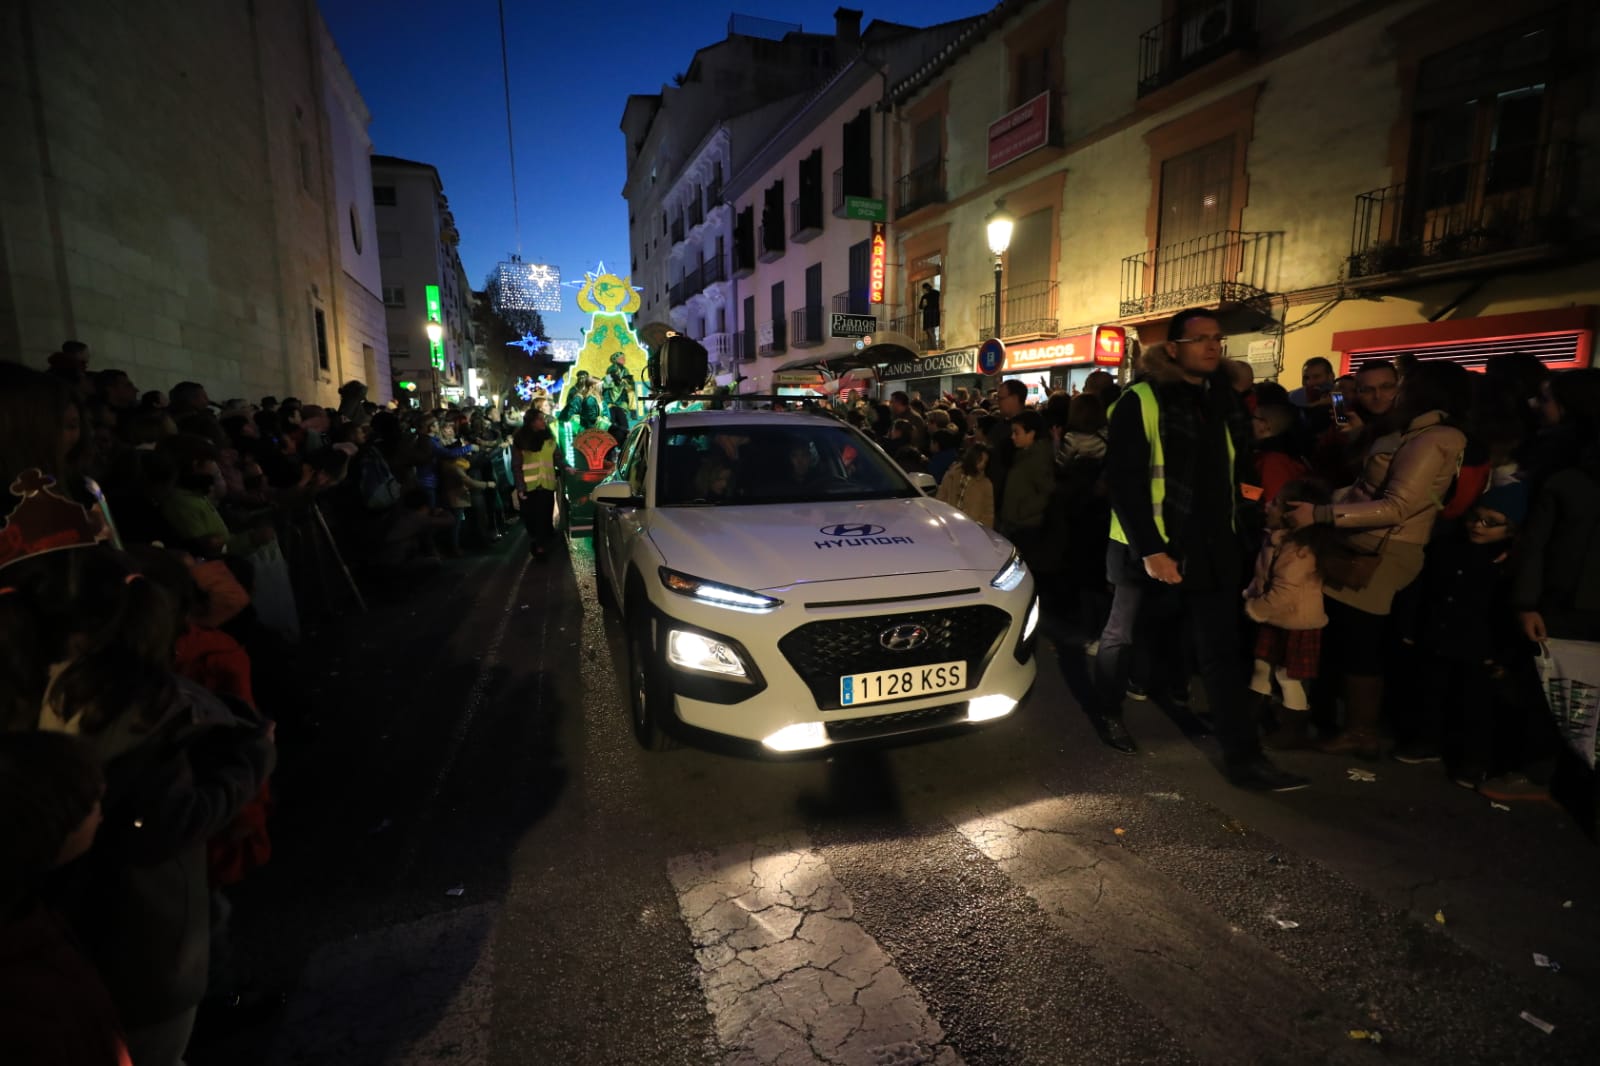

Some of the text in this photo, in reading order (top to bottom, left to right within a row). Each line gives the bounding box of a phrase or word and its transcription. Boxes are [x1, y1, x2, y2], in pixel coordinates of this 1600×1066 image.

[872, 223, 884, 302] TABACOS
[833, 314, 876, 327] Pianos
[924, 352, 974, 371] OCASIÓN
[1012, 343, 1075, 362] TABACOS
[814, 536, 915, 550] HYUNDAI
[861, 666, 960, 699] 1128 KSS
